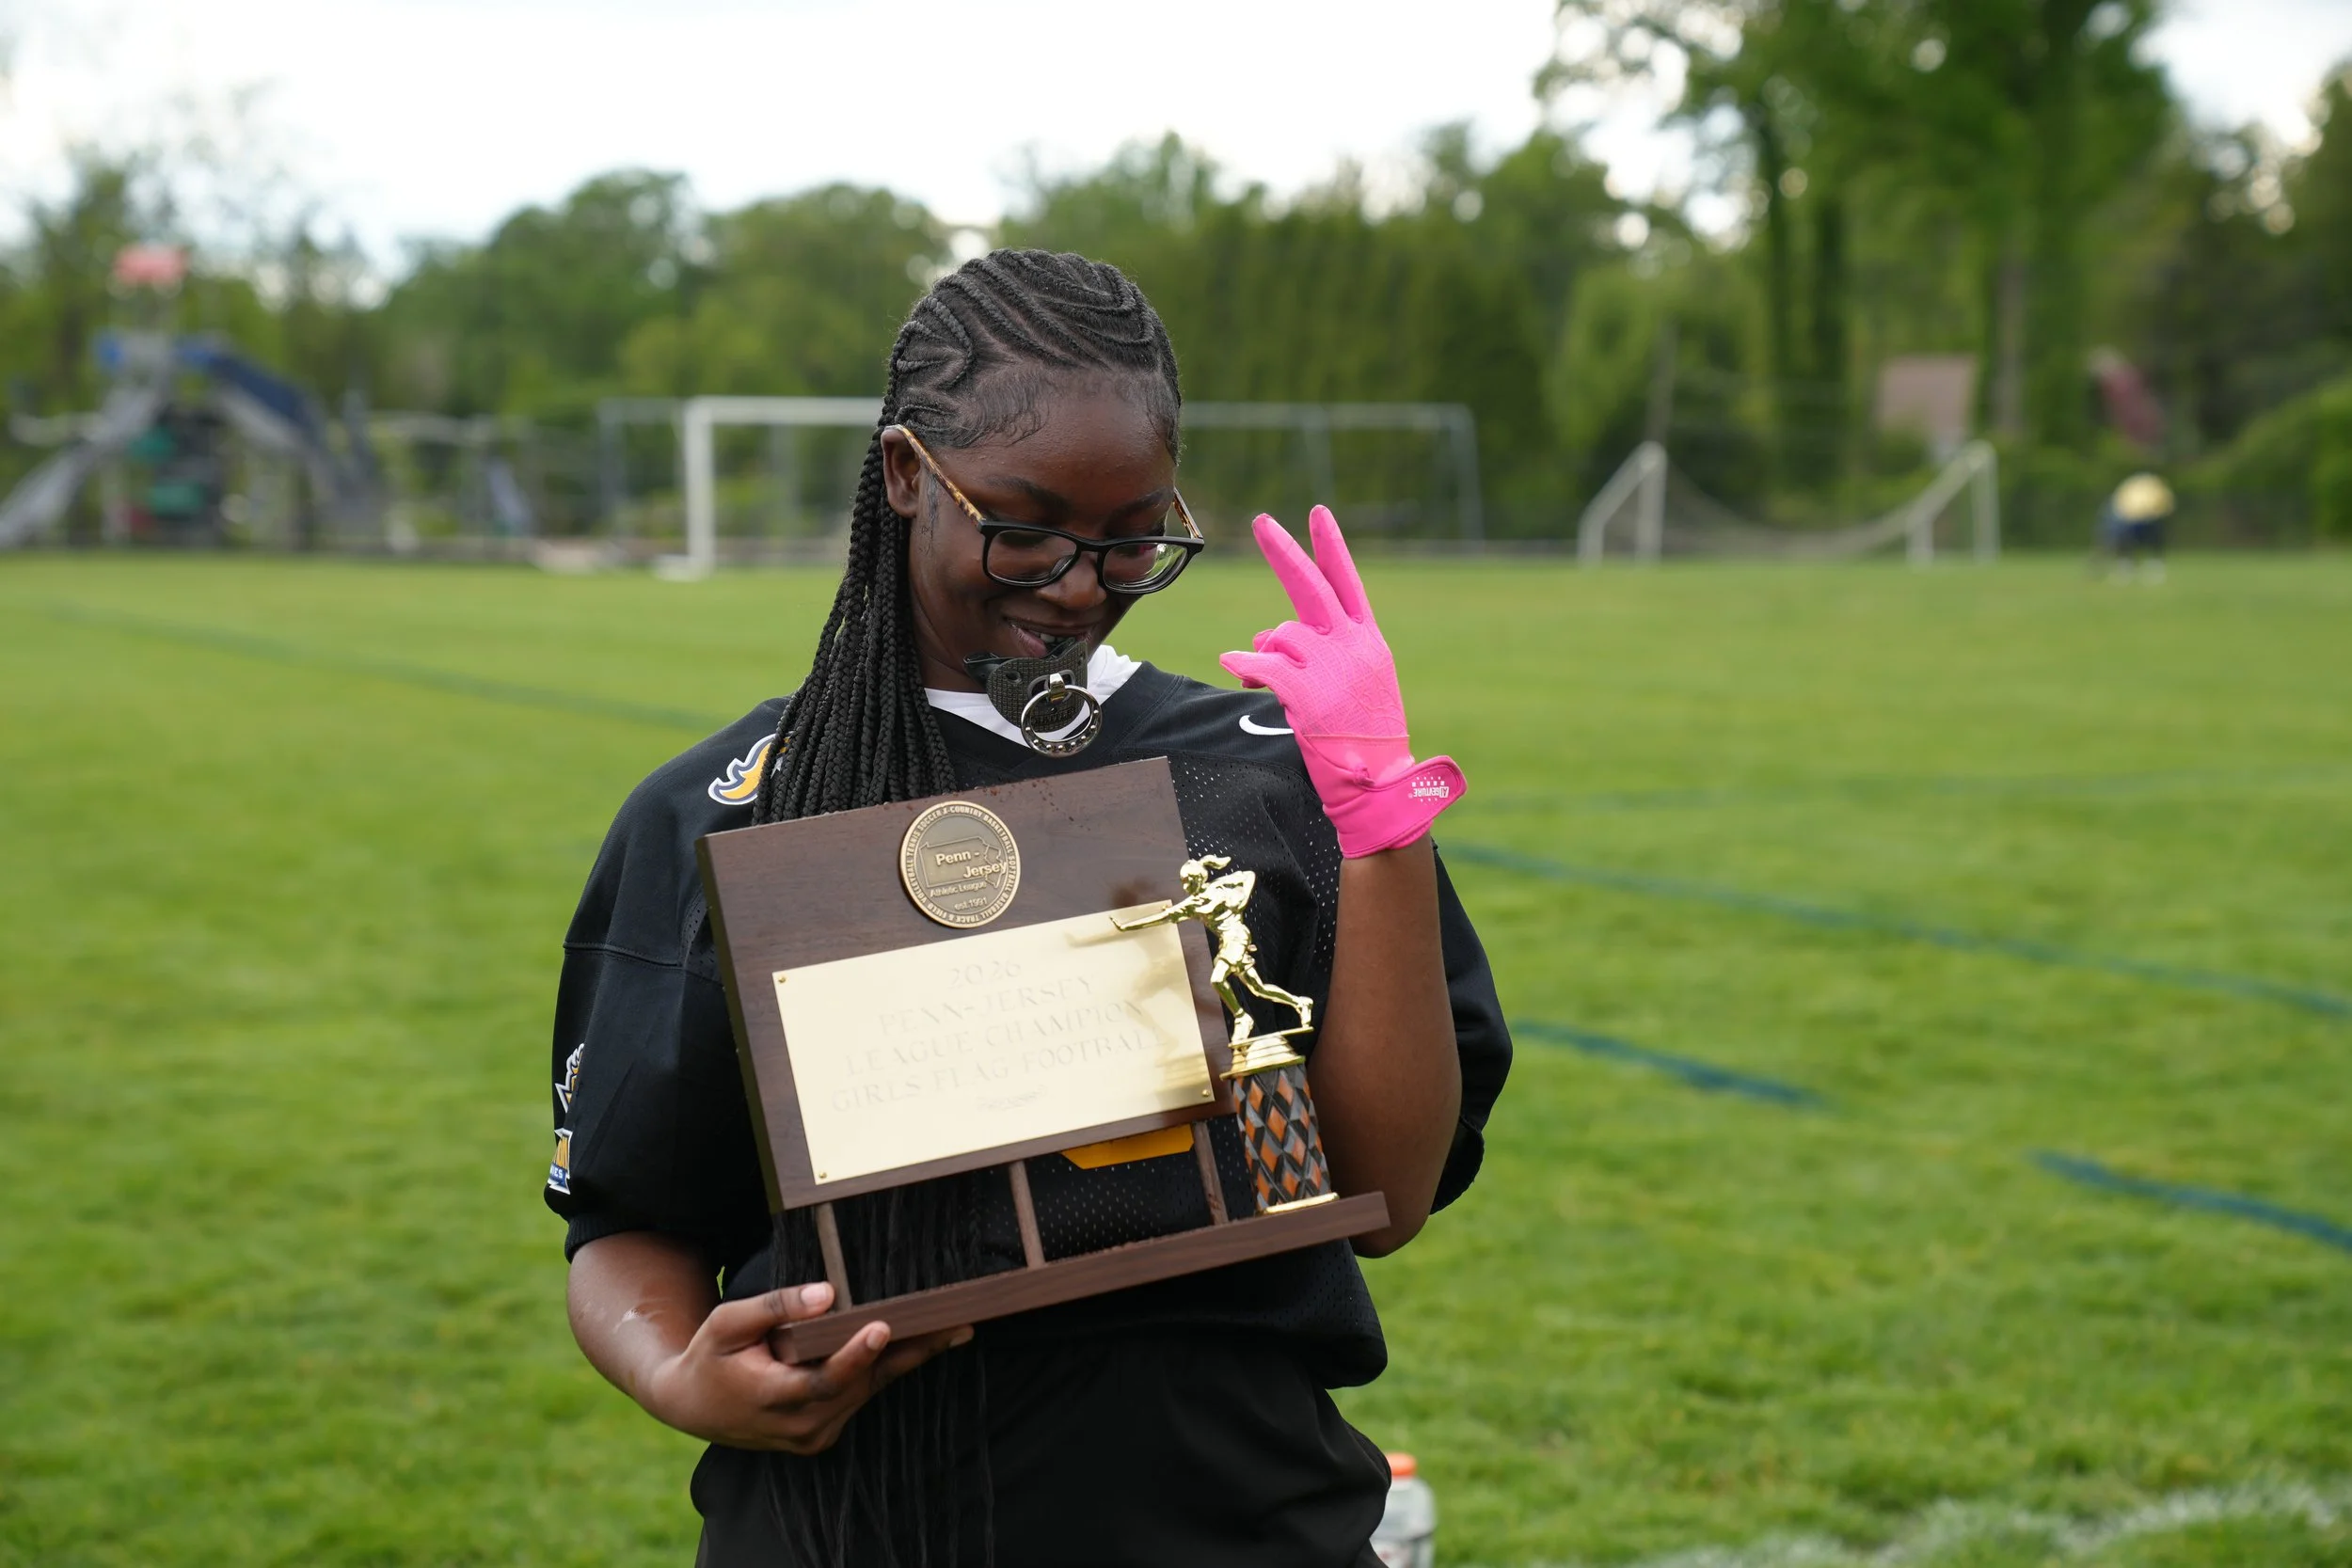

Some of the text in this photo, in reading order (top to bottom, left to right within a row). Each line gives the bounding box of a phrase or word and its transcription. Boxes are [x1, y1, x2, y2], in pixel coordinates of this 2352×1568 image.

[917, 808, 942, 831] SOCCER
[944, 805, 983, 818] X-COUNTRY
[907, 830, 920, 857] TENNIS
[983, 814, 1013, 853] BASKETBALL
[935, 850, 971, 866] Penn
[962, 862, 1007, 879] Jersey
[906, 859, 926, 903] VOLLEYBALL
[1006, 856, 1016, 892] SOFTBALL
[930, 881, 987, 897] Athletic League
[927, 901, 947, 919] FIELD
[982, 892, 1009, 918] BASEBALL
[956, 914, 979, 923] TRACK
[947, 958, 1022, 990] 2026
[878, 974, 1094, 1037] PENN-JERSEY
[845, 998, 1144, 1079] LEAGUE CHAMPION
[830, 1026, 1170, 1113] GIRLS FLAG FOOTBALL
